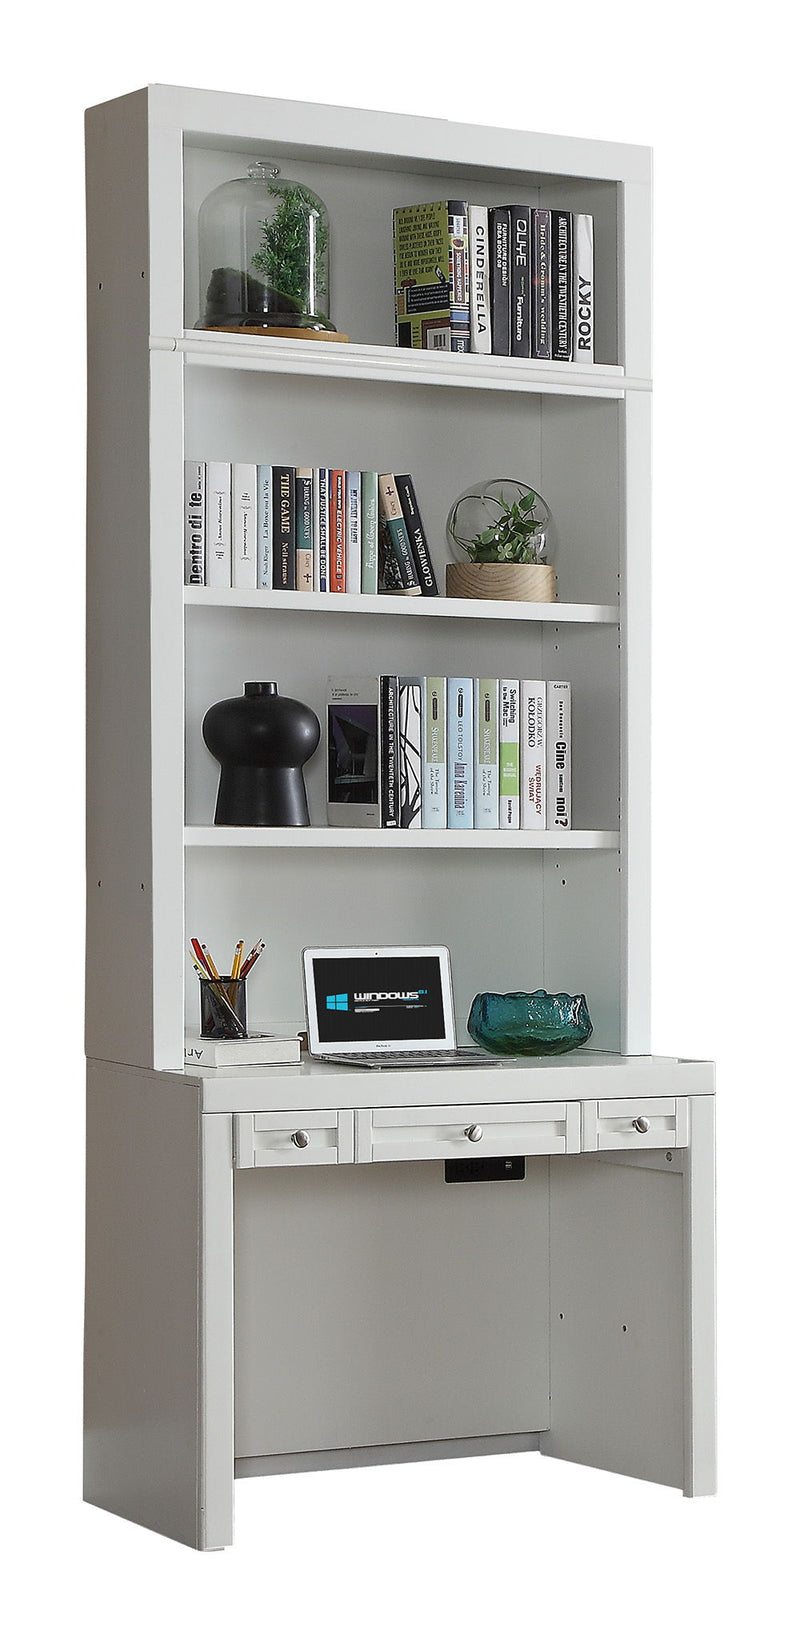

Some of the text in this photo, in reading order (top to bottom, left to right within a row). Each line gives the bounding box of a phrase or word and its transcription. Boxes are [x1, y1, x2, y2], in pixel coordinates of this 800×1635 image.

[540, 252, 546, 260] &
[558, 264, 567, 272] IN
[476, 226, 486, 334] CINDERELLA
[558, 272, 567, 284] THE
[577, 275, 592, 351] ROCKY
[558, 320, 567, 349] CENTURY
[280, 474, 290, 534] THE GAME
[188, 492, 203, 584] Dentro di te
[263, 529, 269, 539] La
[320, 549, 326, 559] BE
[508, 689, 516, 724] Switching
[527, 697, 536, 748] KOŁODKO
[454, 762, 468, 778] Anna
[555, 741, 567, 770] Cine
[454, 779, 468, 809] Karenina
[528, 777, 536, 803] ŚWIAT
[534, 764, 542, 815] WĘDRUJĄCY
